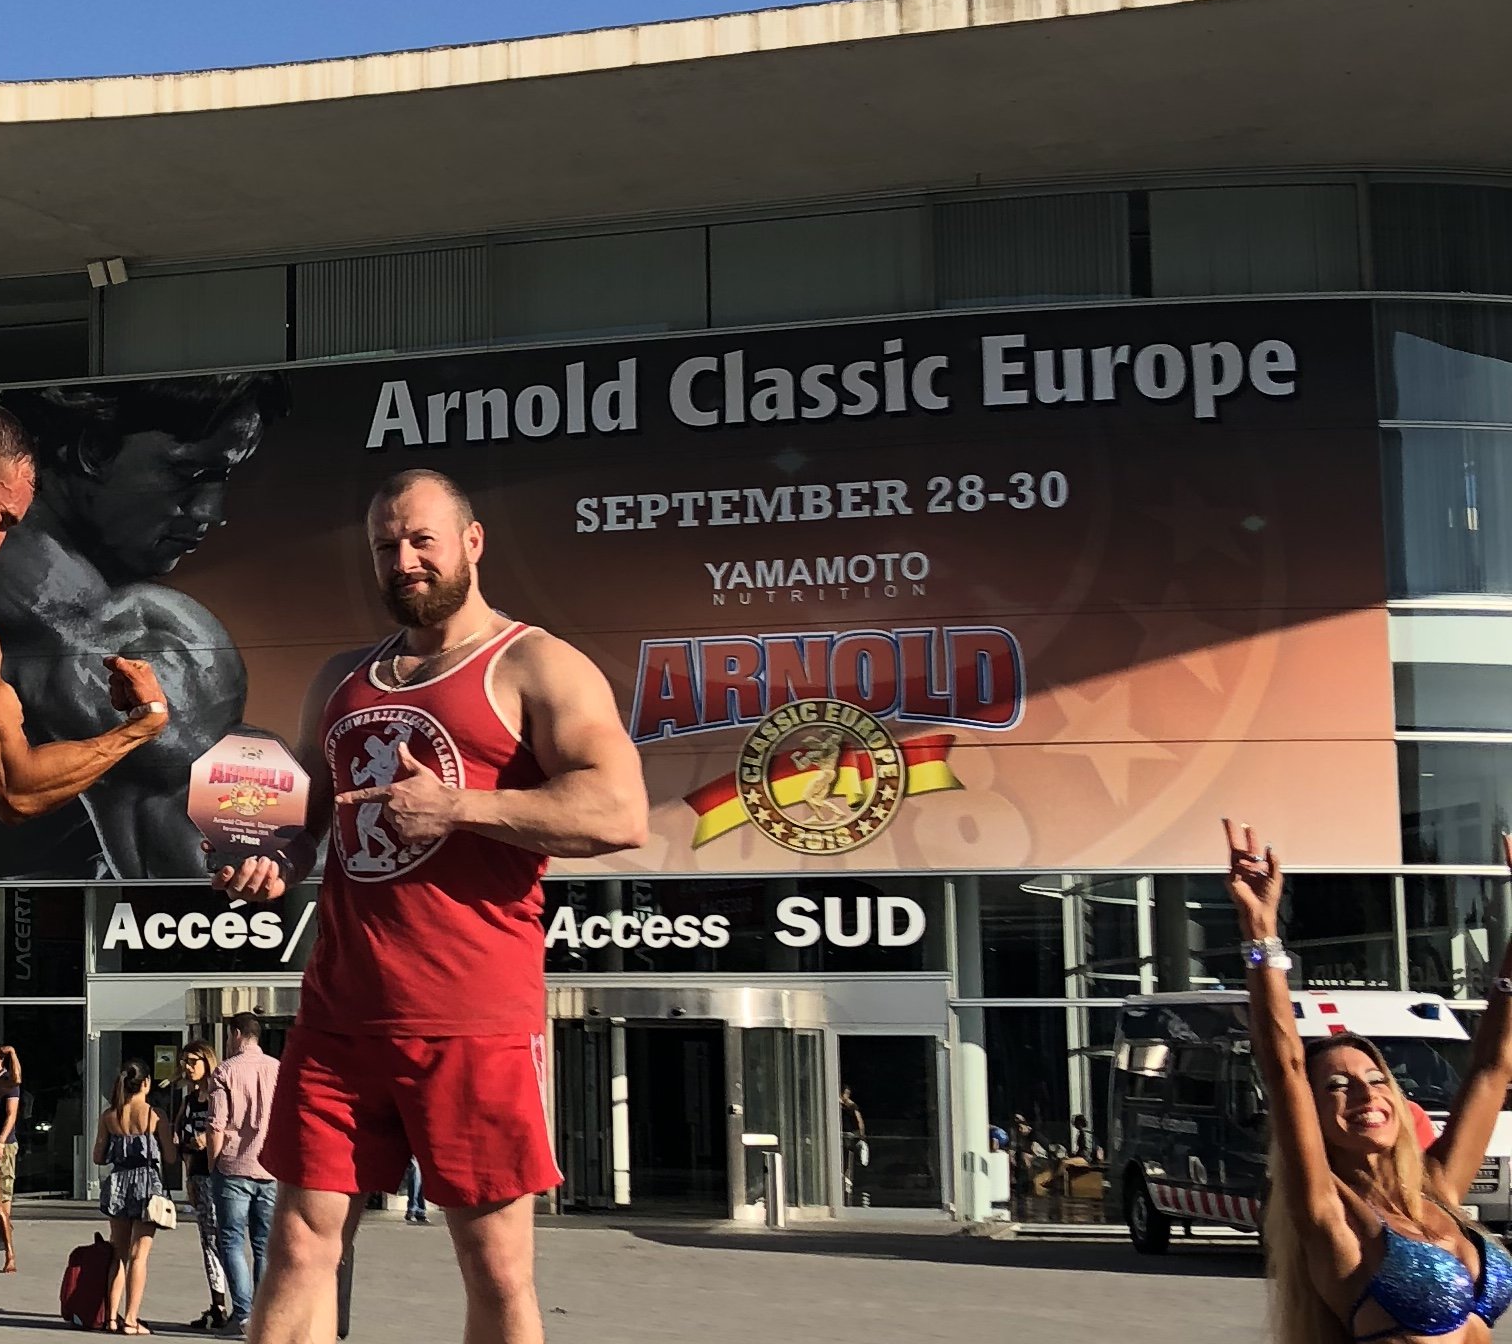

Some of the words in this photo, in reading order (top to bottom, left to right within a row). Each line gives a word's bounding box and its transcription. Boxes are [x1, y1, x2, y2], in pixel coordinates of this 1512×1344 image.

[366, 357, 638, 449] Arnold
[669, 338, 950, 428] Classic
[981, 334, 1297, 419] Europe
[575, 478, 914, 534] SEPTEMBER
[925, 470, 1070, 514] 28-30
[703, 551, 931, 590] YAMAMOTO
[711, 583, 927, 607] NUTRITION
[631, 625, 1027, 745] ARNOLD
[741, 702, 819, 783] CLASSIC
[824, 702, 899, 778] EUROPE
[788, 826, 855, 850] 2018
[544, 905, 731, 949] Access
[773, 895, 927, 948] SUD
